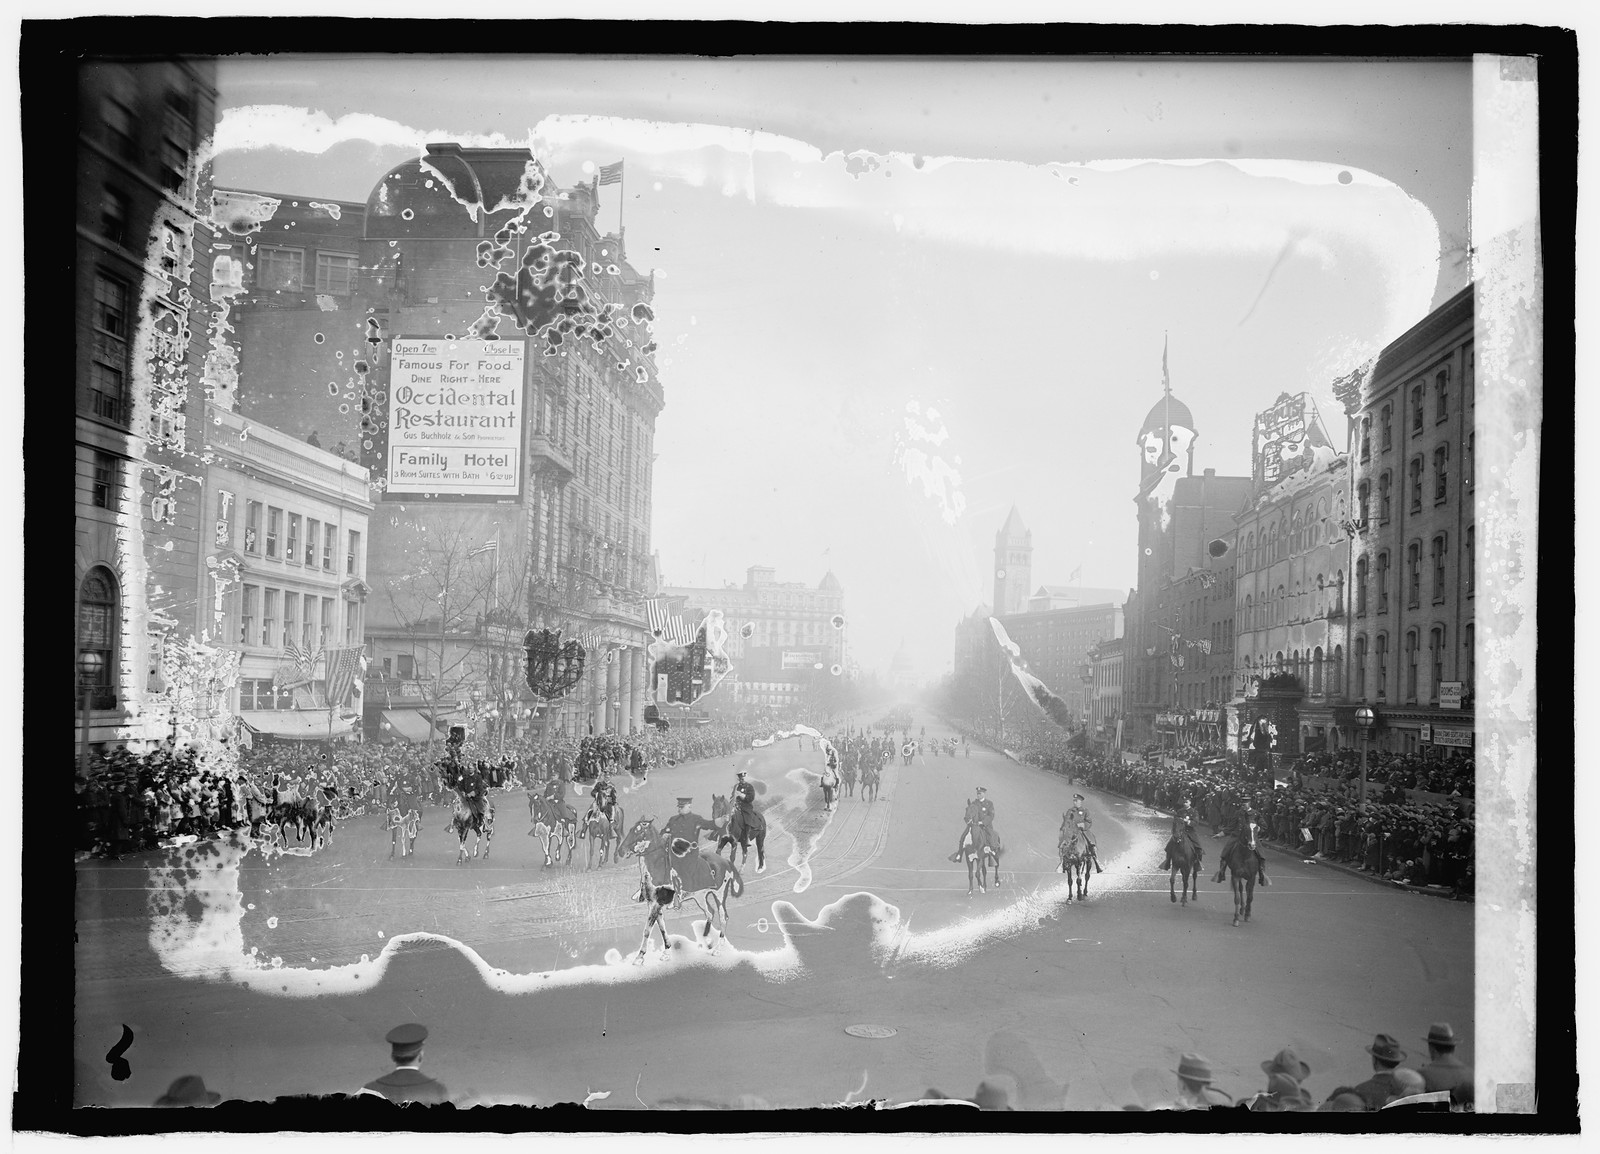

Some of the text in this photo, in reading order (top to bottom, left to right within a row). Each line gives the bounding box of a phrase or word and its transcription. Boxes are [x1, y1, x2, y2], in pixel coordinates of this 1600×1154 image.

[395, 343, 418, 357] Open
[484, 344, 508, 354] Close
[449, 360, 469, 370] For
[411, 374, 432, 383] DINE
[440, 374, 468, 383] RIGHT
[478, 374, 501, 383] HERE
[395, 385, 516, 406] Occidental
[394, 406, 516, 430] Restaurant
[403, 431, 418, 440] Gus
[420, 431, 452, 440] Buchholz
[462, 432, 476, 441] Son
[399, 452, 509, 471] Family Hotel
[394, 470, 399, 478] 3
[400, 469, 417, 478] ROOM
[418, 469, 441, 479] SUITES
[442, 472, 460, 480] WITH
[462, 471, 480, 480] BATH
